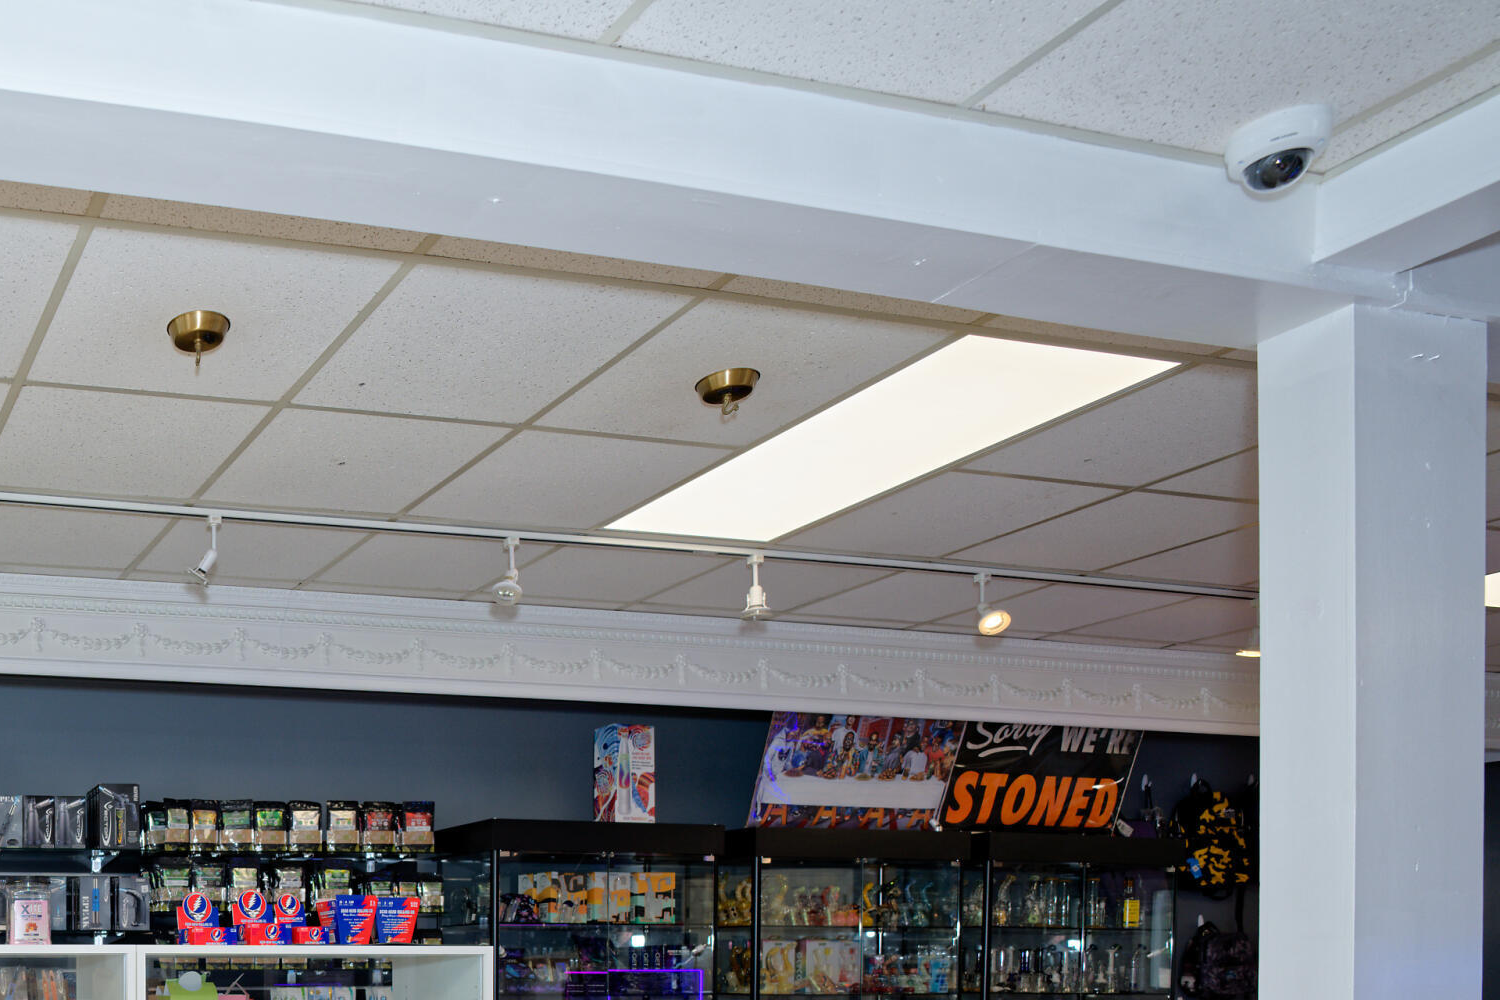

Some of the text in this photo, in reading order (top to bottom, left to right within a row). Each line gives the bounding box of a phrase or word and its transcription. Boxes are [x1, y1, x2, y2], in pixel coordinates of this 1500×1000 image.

[966, 721, 1136, 756] Sorry WE'RE
[946, 770, 1119, 829] STONED
